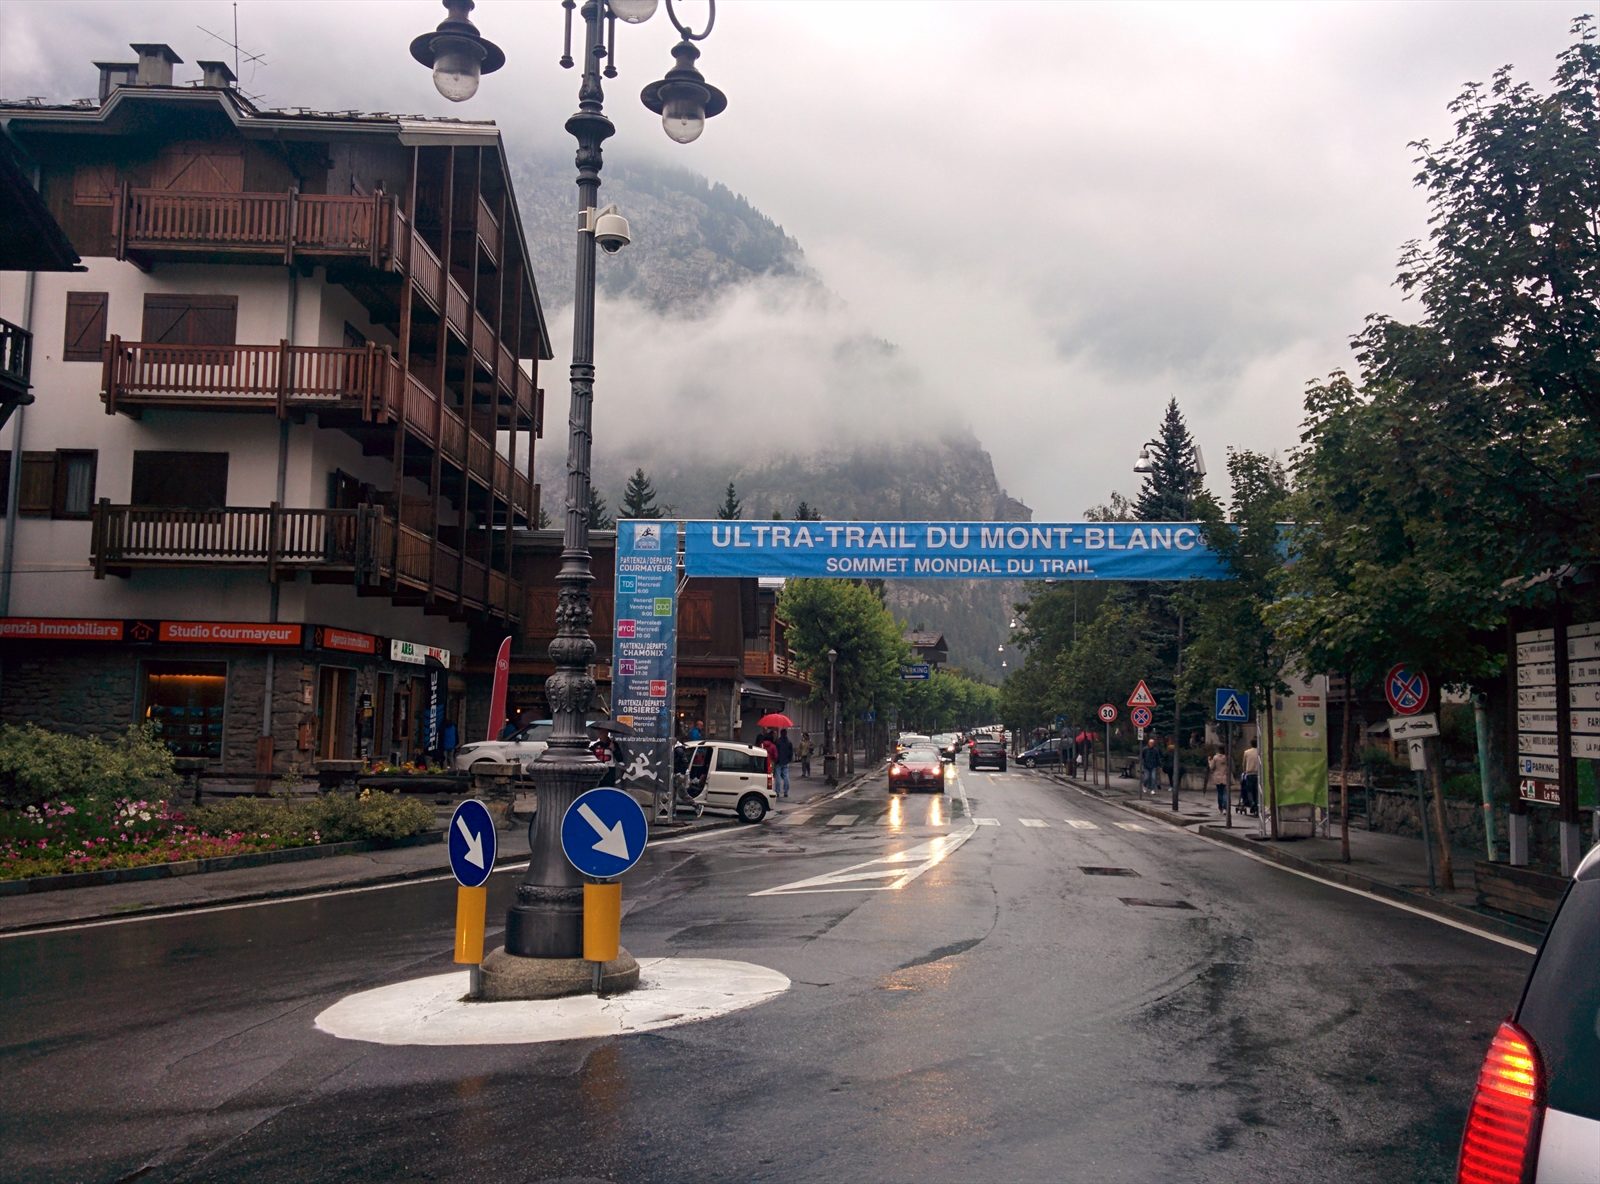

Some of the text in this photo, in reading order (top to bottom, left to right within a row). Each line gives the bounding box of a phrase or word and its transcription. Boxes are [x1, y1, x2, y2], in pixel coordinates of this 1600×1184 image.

[711, 526, 916, 550] ULTRA-TRAIL
[926, 527, 969, 550] DU
[620, 564, 672, 573] COURMAYEUR
[826, 557, 1094, 574] SOMMET MONDIAL DU TRAIL
[622, 580, 634, 588] TDS
[39, 622, 119, 636] Immobiliare
[168, 625, 292, 642] Studio Courmayeur
[402, 642, 414, 656] AREA
[623, 649, 664, 657] CHAMONIX
[623, 706, 660, 714] ORSIERES
[1103, 709, 1113, 718] 30
[1532, 762, 1555, 774] PARKING
[1544, 790, 1551, 800] Le
